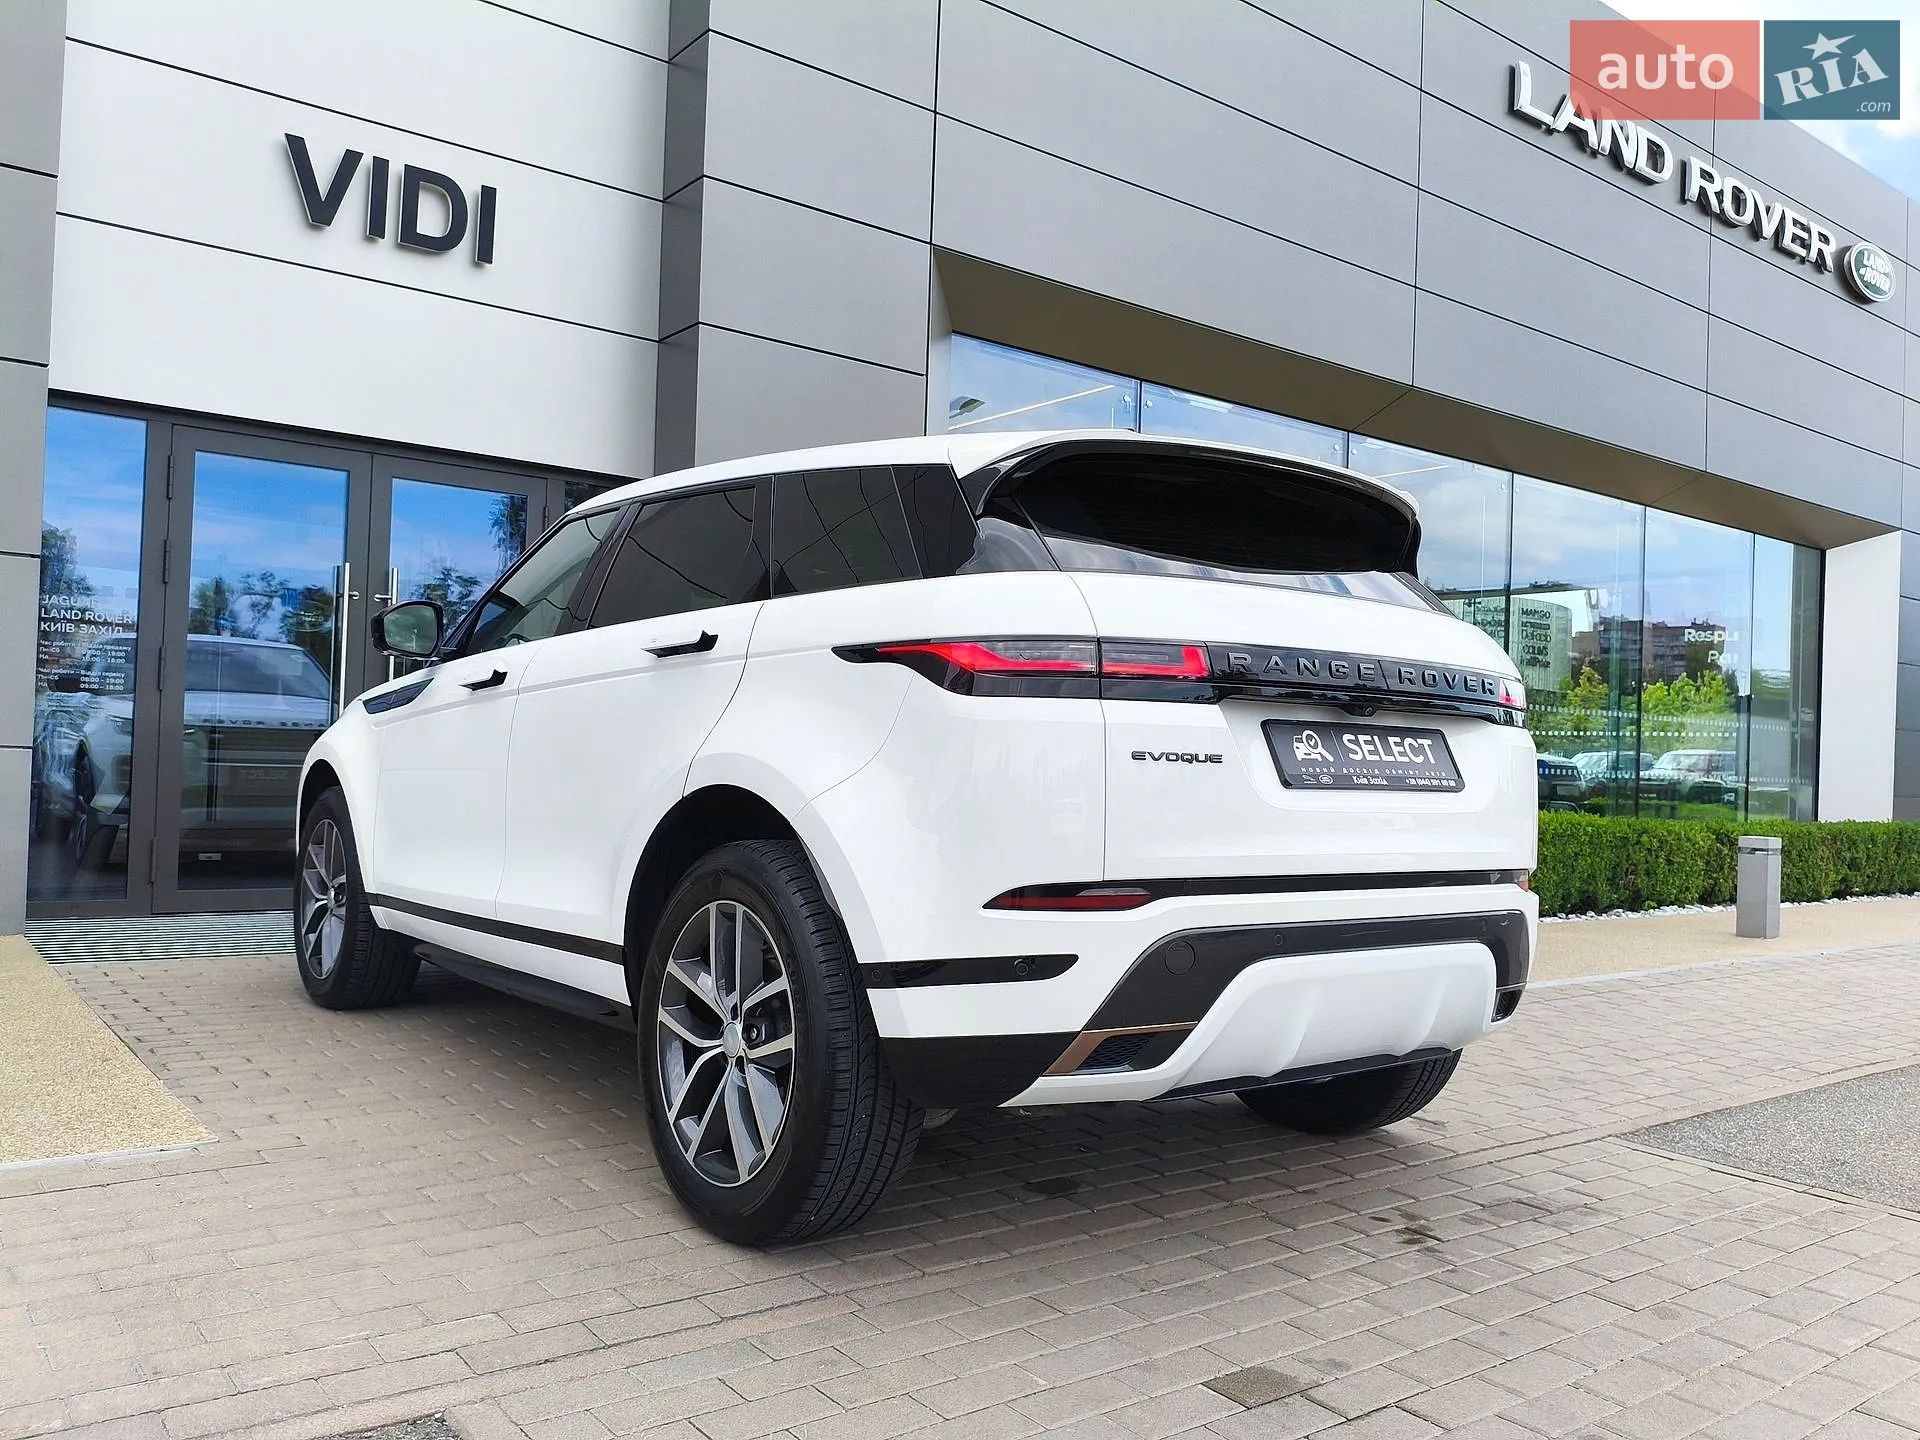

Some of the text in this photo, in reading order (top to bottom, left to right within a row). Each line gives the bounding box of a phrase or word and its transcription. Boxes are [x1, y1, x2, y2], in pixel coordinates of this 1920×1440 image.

[1508, 60, 1838, 274] LAND ROVER
[284, 132, 498, 265] VIDI
[41, 607, 133, 624] LAND ROVER
[1521, 607, 1551, 619] MANGO
[40, 620, 124, 637] КИЇВ ЗАХІД
[1226, 651, 1496, 696] RANGE ROVER
[1130, 750, 1223, 763] EVOQUE
[1341, 733, 1436, 764] SELECT
